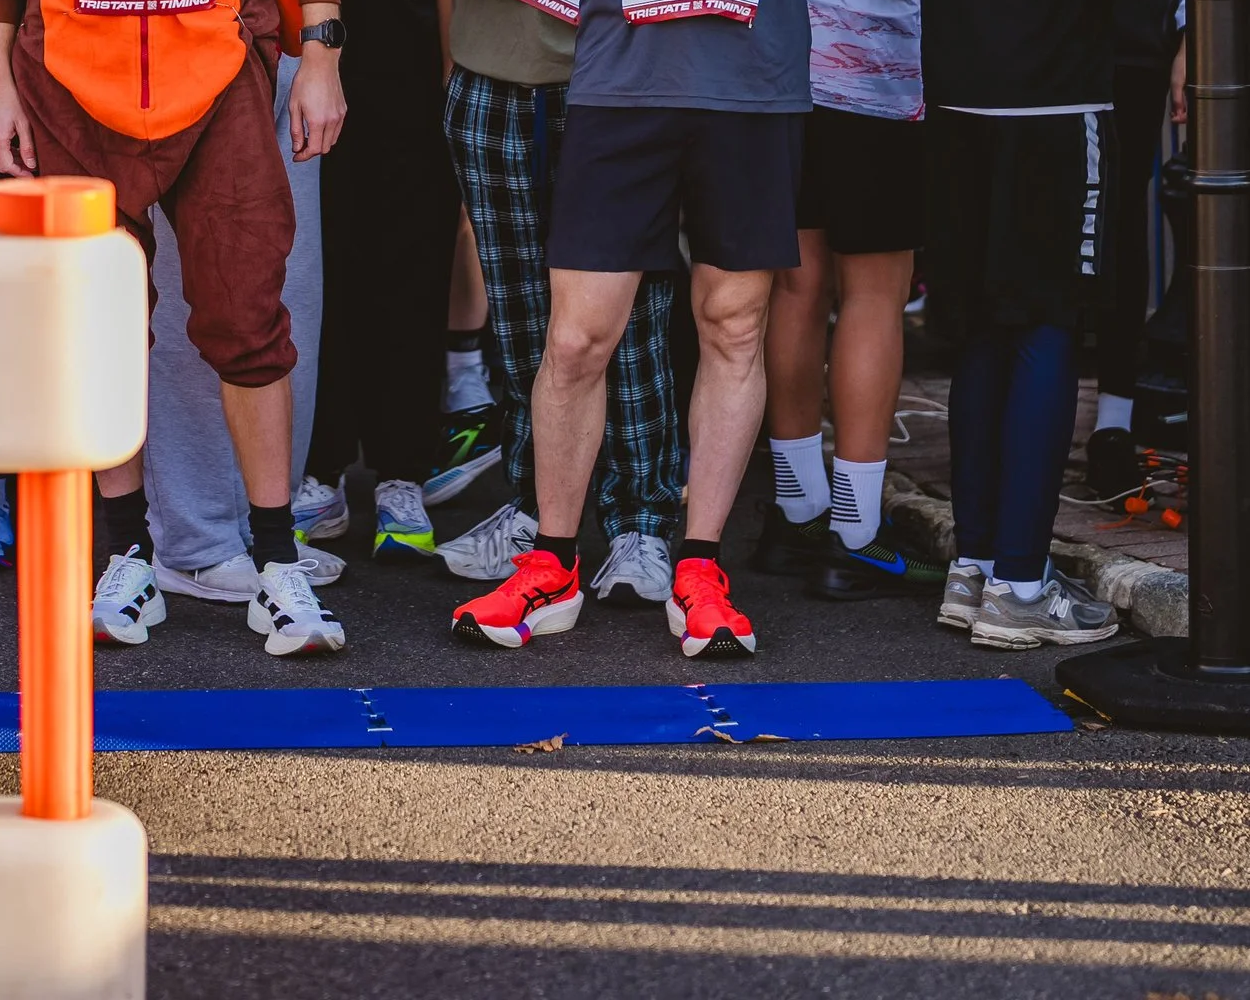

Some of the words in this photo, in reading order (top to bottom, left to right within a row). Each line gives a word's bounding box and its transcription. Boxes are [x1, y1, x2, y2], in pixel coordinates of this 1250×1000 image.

[78, 0, 144, 10] TRISTATE
[628, 2, 691, 20] TRISTATE
[706, 0, 751, 16] TIMING
